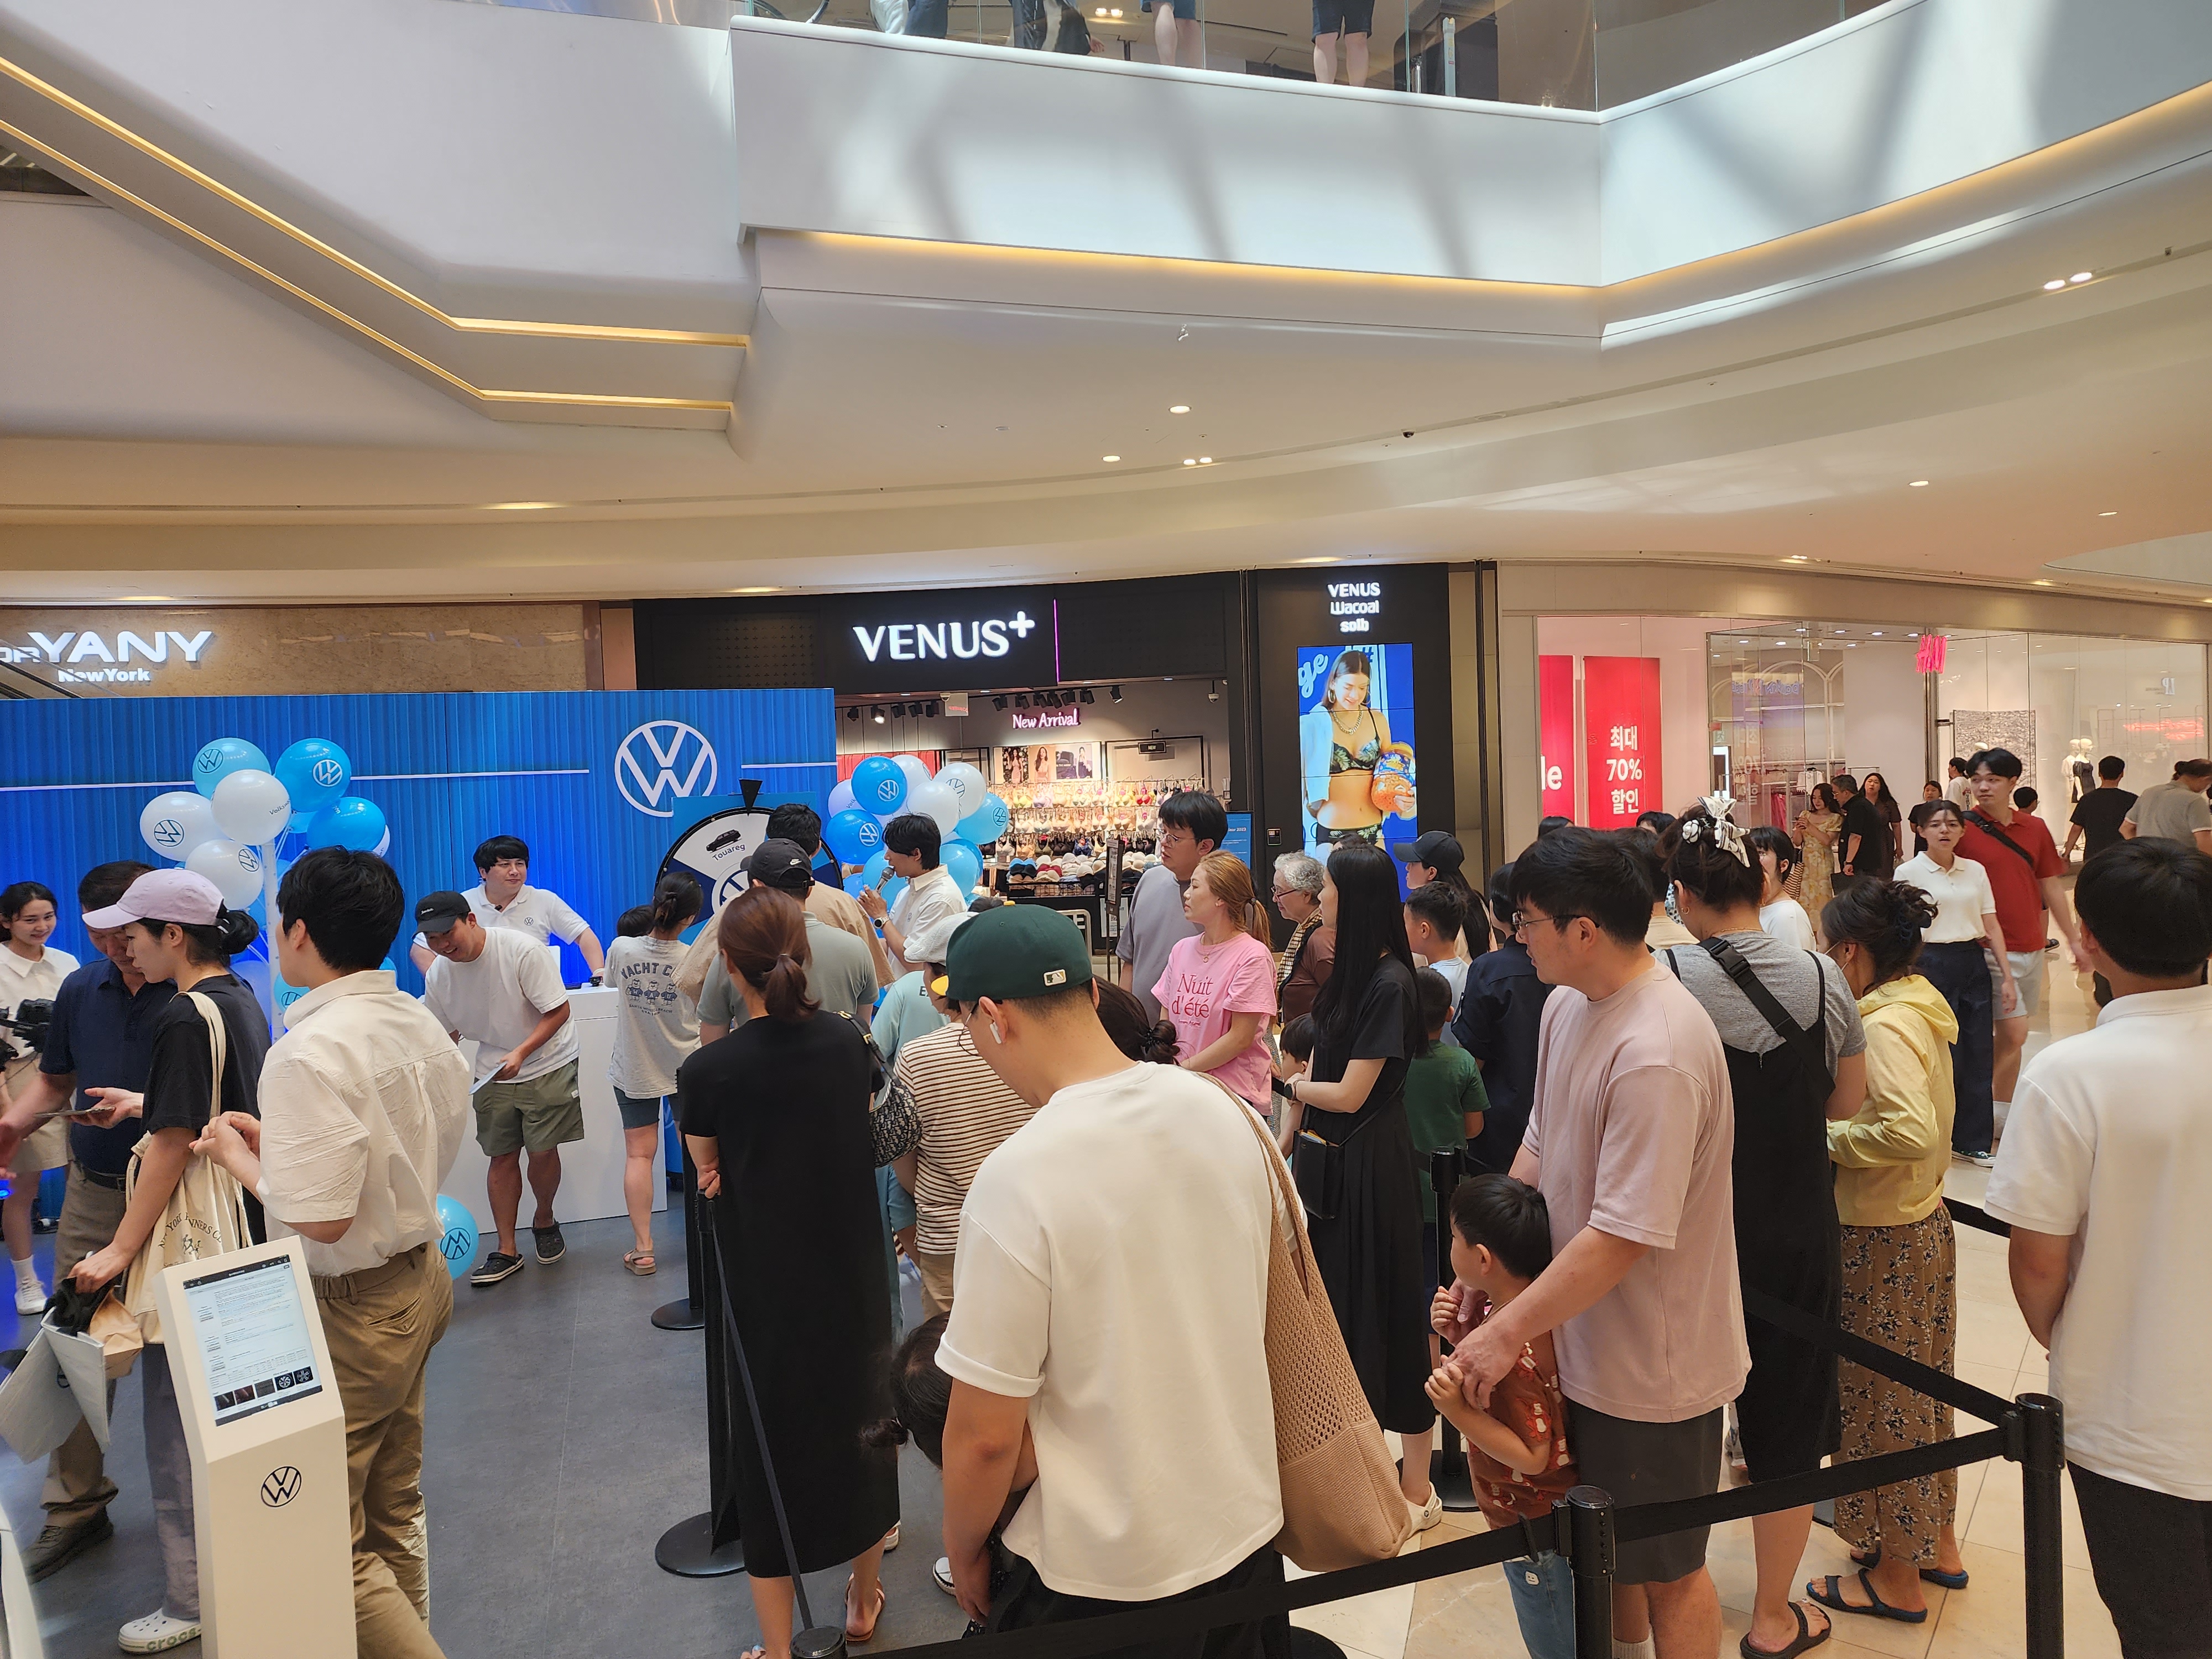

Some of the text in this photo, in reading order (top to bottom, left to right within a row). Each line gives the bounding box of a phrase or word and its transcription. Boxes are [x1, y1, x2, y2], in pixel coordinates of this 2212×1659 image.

[1327, 582, 1381, 597] VENUS
[1330, 600, 1380, 615] Wacoal
[1012, 708, 1079, 729] New Arrival
[1610, 726, 1638, 751] 최대
[1606, 758, 1642, 781] 70%
[1611, 788, 1639, 815] 할인
[712, 843, 746, 862] Touareg
[620, 962, 660, 979] YACHT
[1177, 974, 1214, 995] Nuit
[1172, 995, 1209, 1018] d'été
[147, 1627, 196, 1650] crocs
